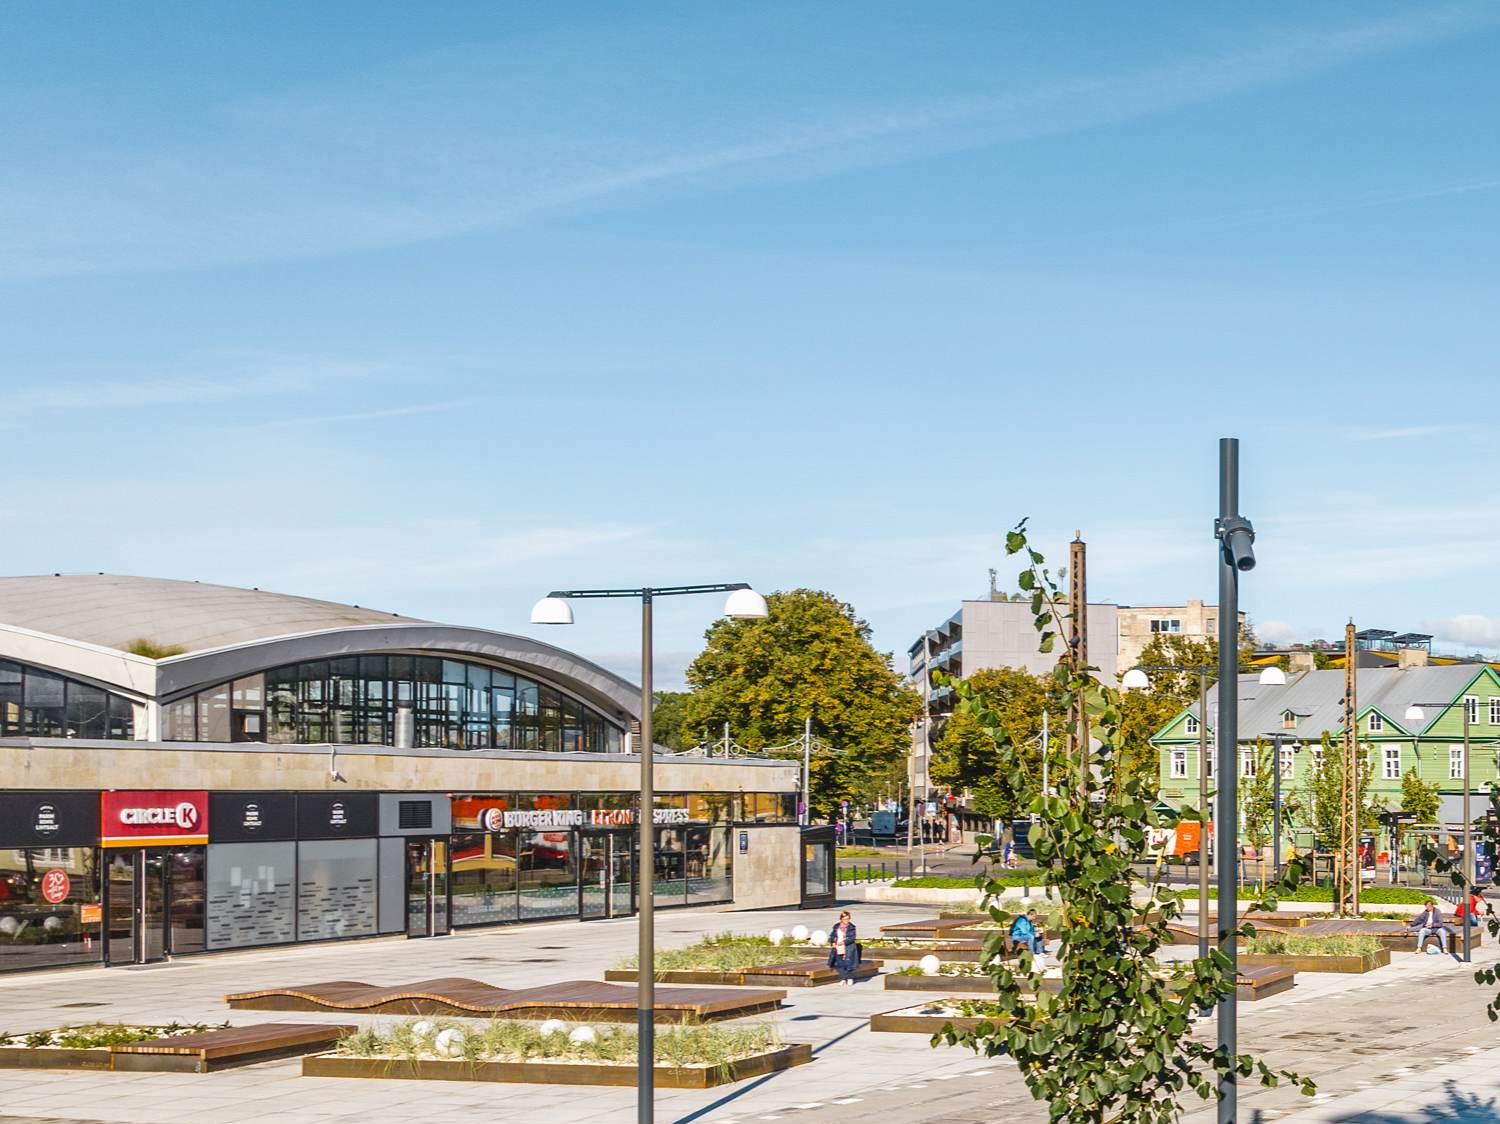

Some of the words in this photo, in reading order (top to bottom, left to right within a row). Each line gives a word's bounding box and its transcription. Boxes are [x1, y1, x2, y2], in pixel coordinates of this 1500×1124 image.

[120, 808, 176, 825] CIRCLE
[504, 809, 553, 827] BURGER
[553, 809, 583, 826] KING
